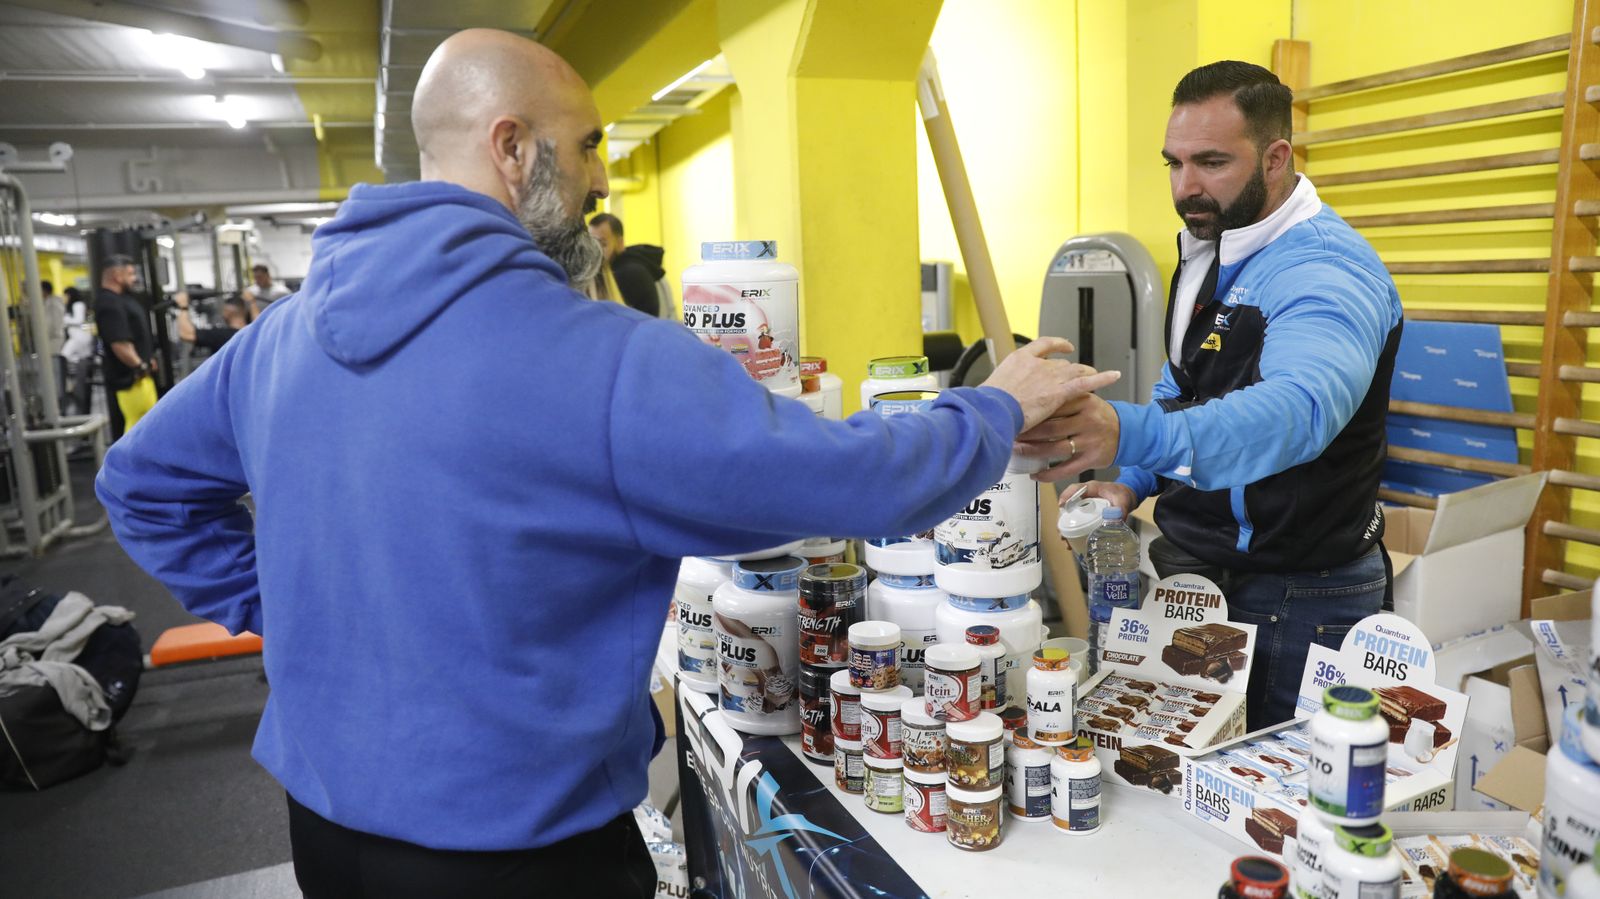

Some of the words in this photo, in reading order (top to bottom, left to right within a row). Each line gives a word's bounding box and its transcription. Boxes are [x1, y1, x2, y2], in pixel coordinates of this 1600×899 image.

[712, 243, 750, 253] ERIX
[741, 288, 772, 298] ERIX
[702, 312, 746, 328] PLUS
[875, 366, 905, 376] ERIX
[988, 482, 1012, 490] RIX
[1106, 583, 1127, 591] Font
[1173, 581, 1205, 590] Quamtrax
[1106, 591, 1127, 600] Vella
[1154, 588, 1221, 608] PROTEIN
[680, 609, 712, 627] PLUS
[1164, 605, 1205, 622] BARS
[1120, 619, 1150, 635] 36%
[1375, 624, 1411, 641] Quamtrax
[1118, 633, 1148, 643] PROTEIN
[720, 641, 757, 662] PLUS
[1106, 652, 1139, 662] CHOCOLATE
[1353, 629, 1429, 668] PROTEIN
[1316, 661, 1347, 685] 36%
[1364, 652, 1408, 680] BARS
[902, 728, 931, 745] Praline
[1184, 762, 1192, 811] Quamtrax
[1195, 766, 1256, 809] PROTEIN
[1195, 784, 1231, 814] BARS
[1413, 788, 1446, 811] BARS
[658, 881, 690, 899] PLU
